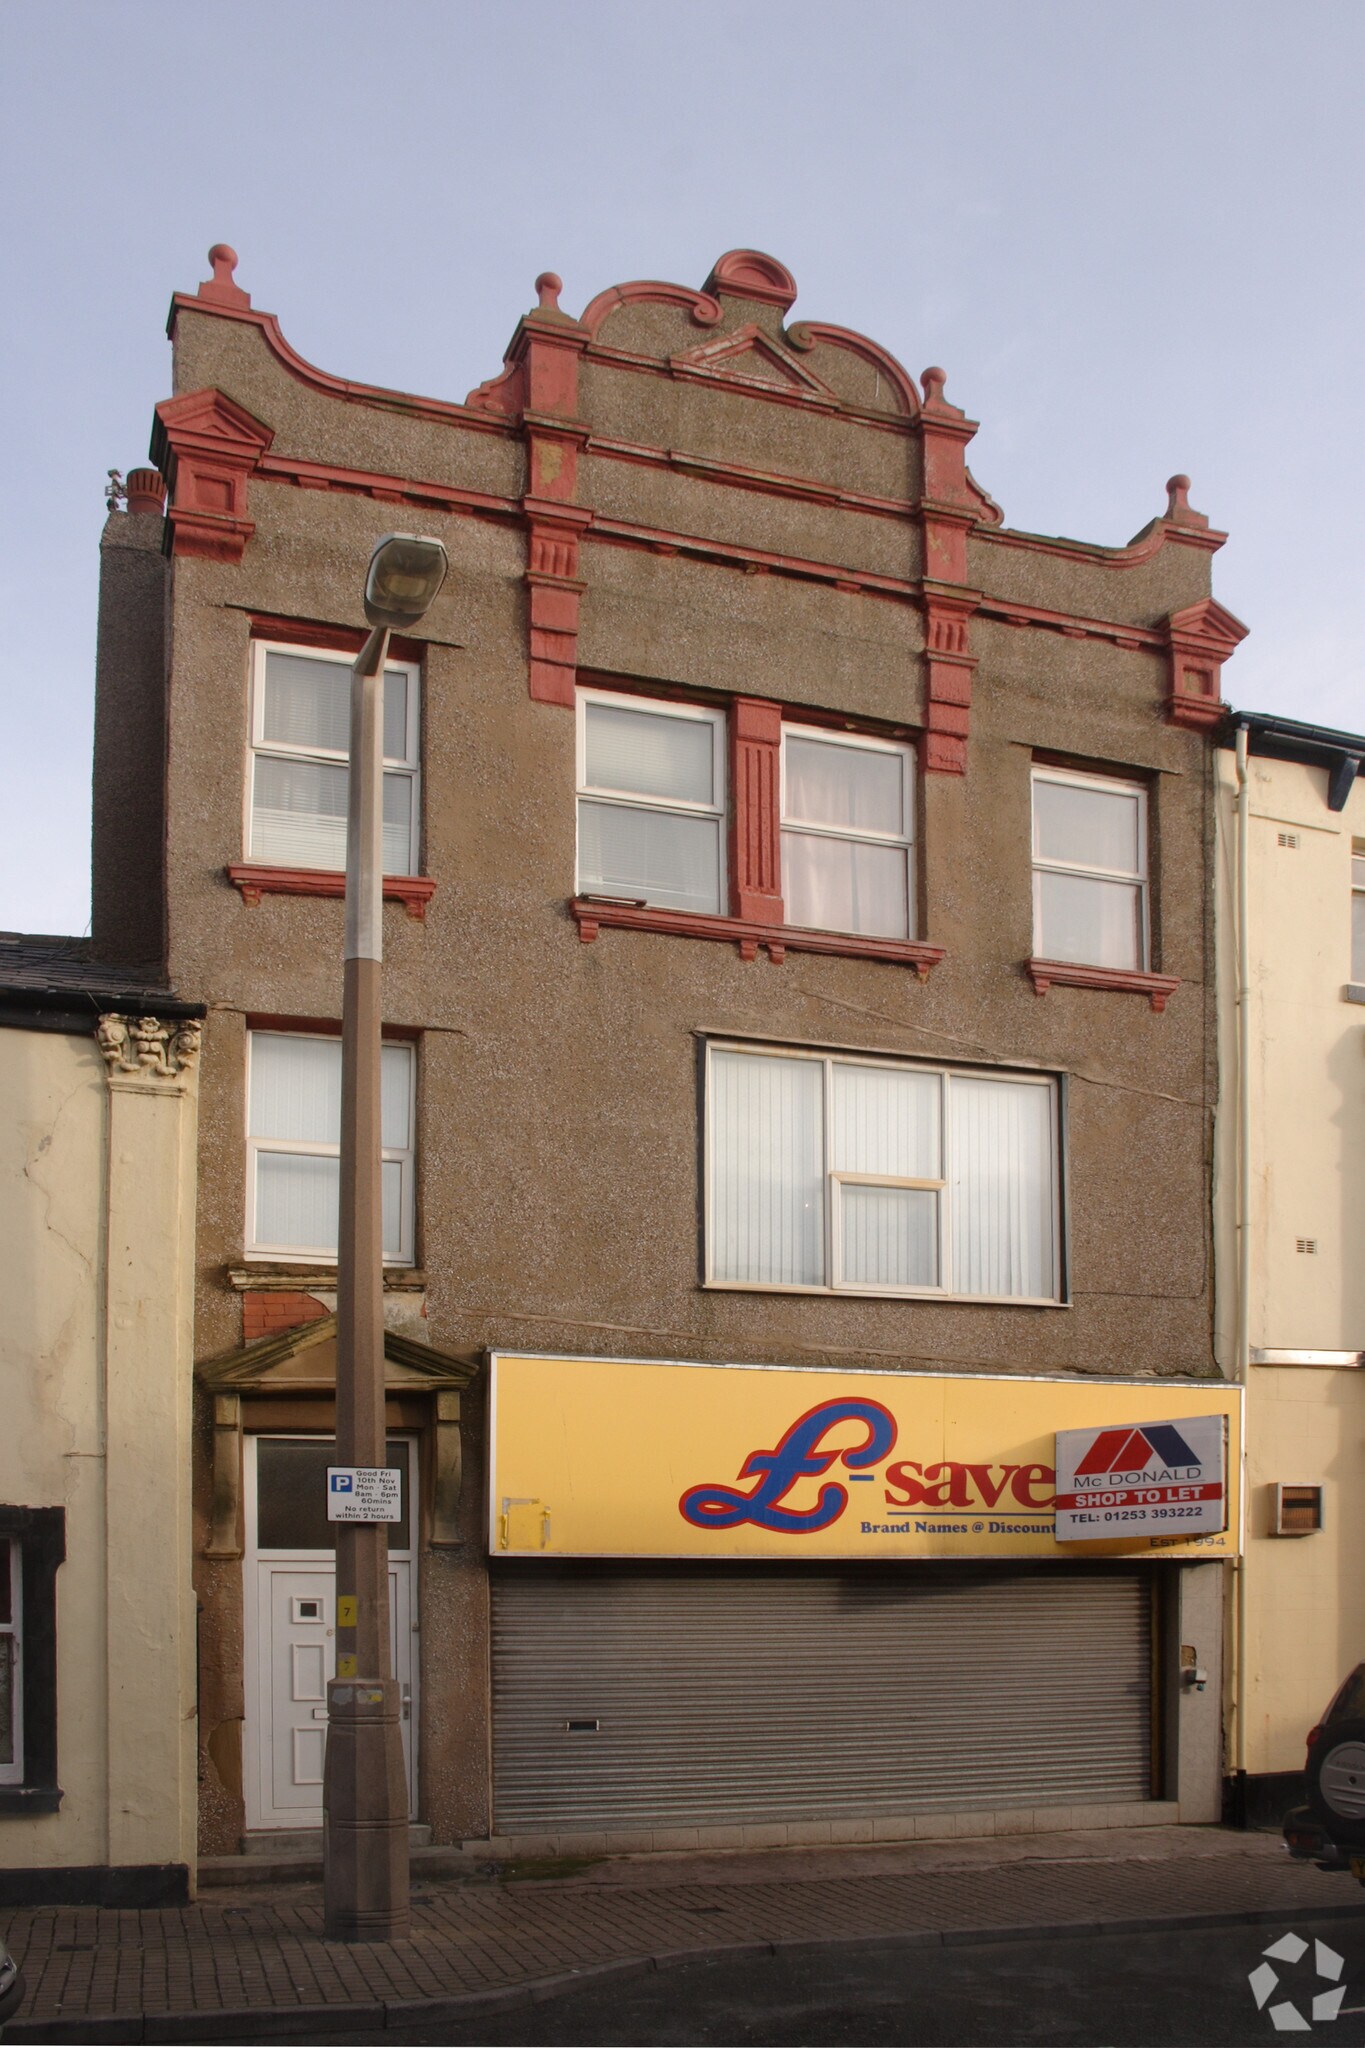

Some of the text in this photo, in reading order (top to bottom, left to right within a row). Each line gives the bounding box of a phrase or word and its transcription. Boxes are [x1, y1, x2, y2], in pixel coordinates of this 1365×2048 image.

[885, 1460, 1056, 1509] save
[1073, 1467, 1201, 1488] Mc DONALD
[1075, 1486, 1204, 1507] SHOP TO LET
[1070, 1507, 1203, 1523] TEL: 01253 393222
[861, 1521, 910, 1534] Brand
[915, 1521, 968, 1534] Names
[972, 1522, 985, 1534] @
[1185, 1537, 1226, 1547] 1994
[344, 1607, 351, 1616] 7
